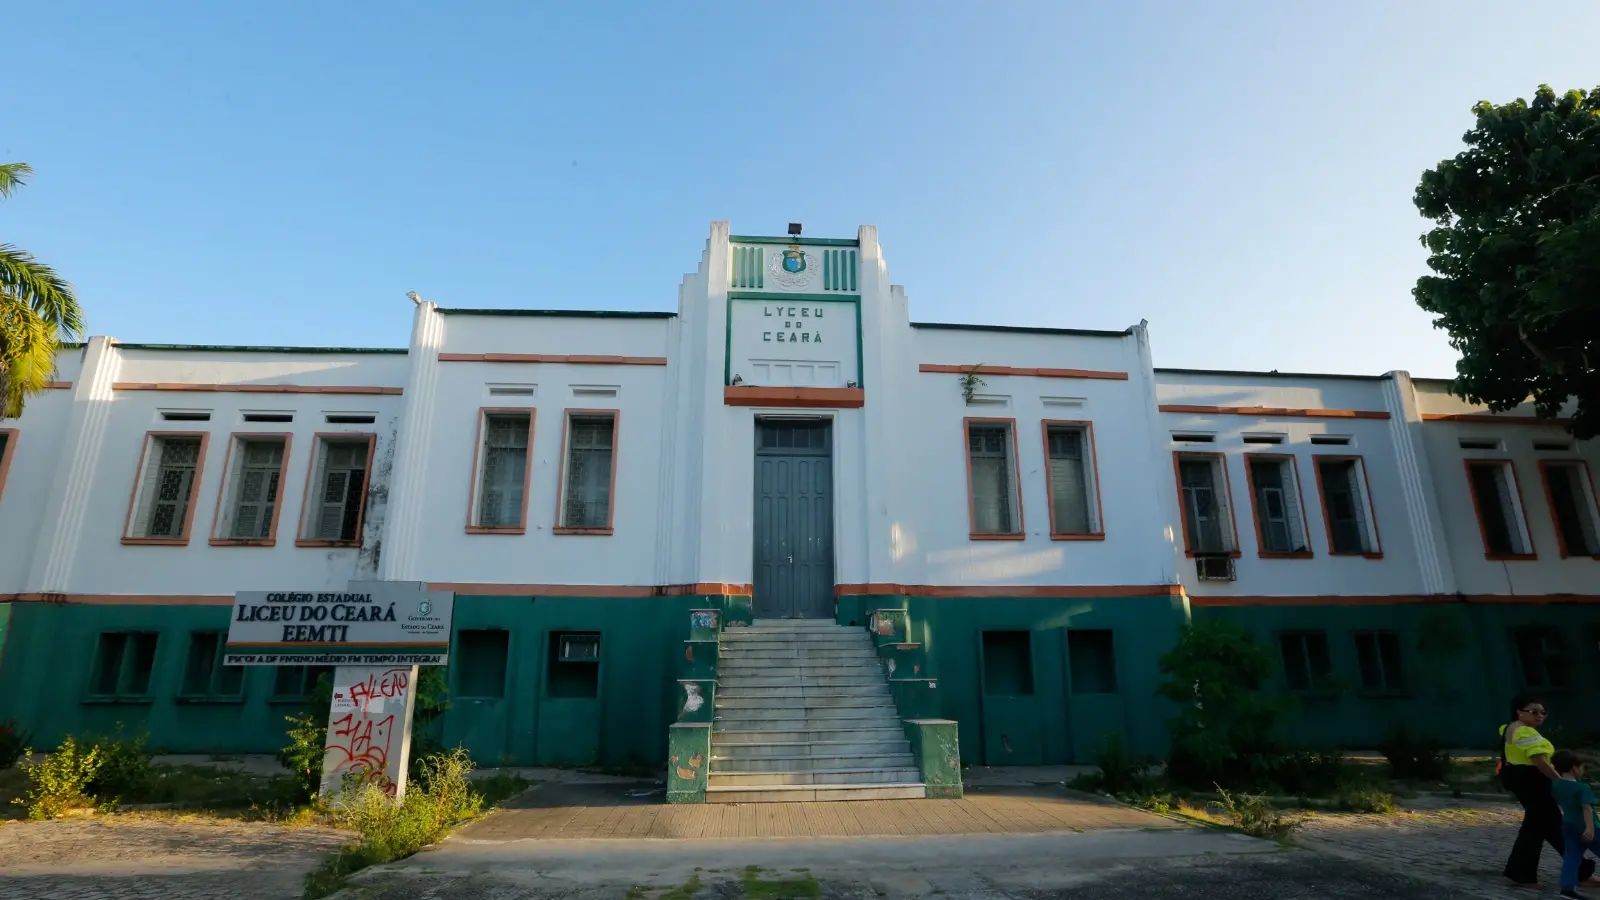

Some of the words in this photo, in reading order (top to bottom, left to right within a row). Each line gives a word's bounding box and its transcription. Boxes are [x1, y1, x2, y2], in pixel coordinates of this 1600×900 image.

[764, 306, 823, 317] LYCEU
[266, 591, 314, 603] COLÉGIO
[317, 593, 373, 603] ESTADUAL
[236, 604, 297, 622] LICEU
[299, 605, 328, 622] DO
[330, 602, 397, 622] CEARÁ
[281, 625, 349, 642] EEMTI
[363, 655, 395, 663] TEMPO
